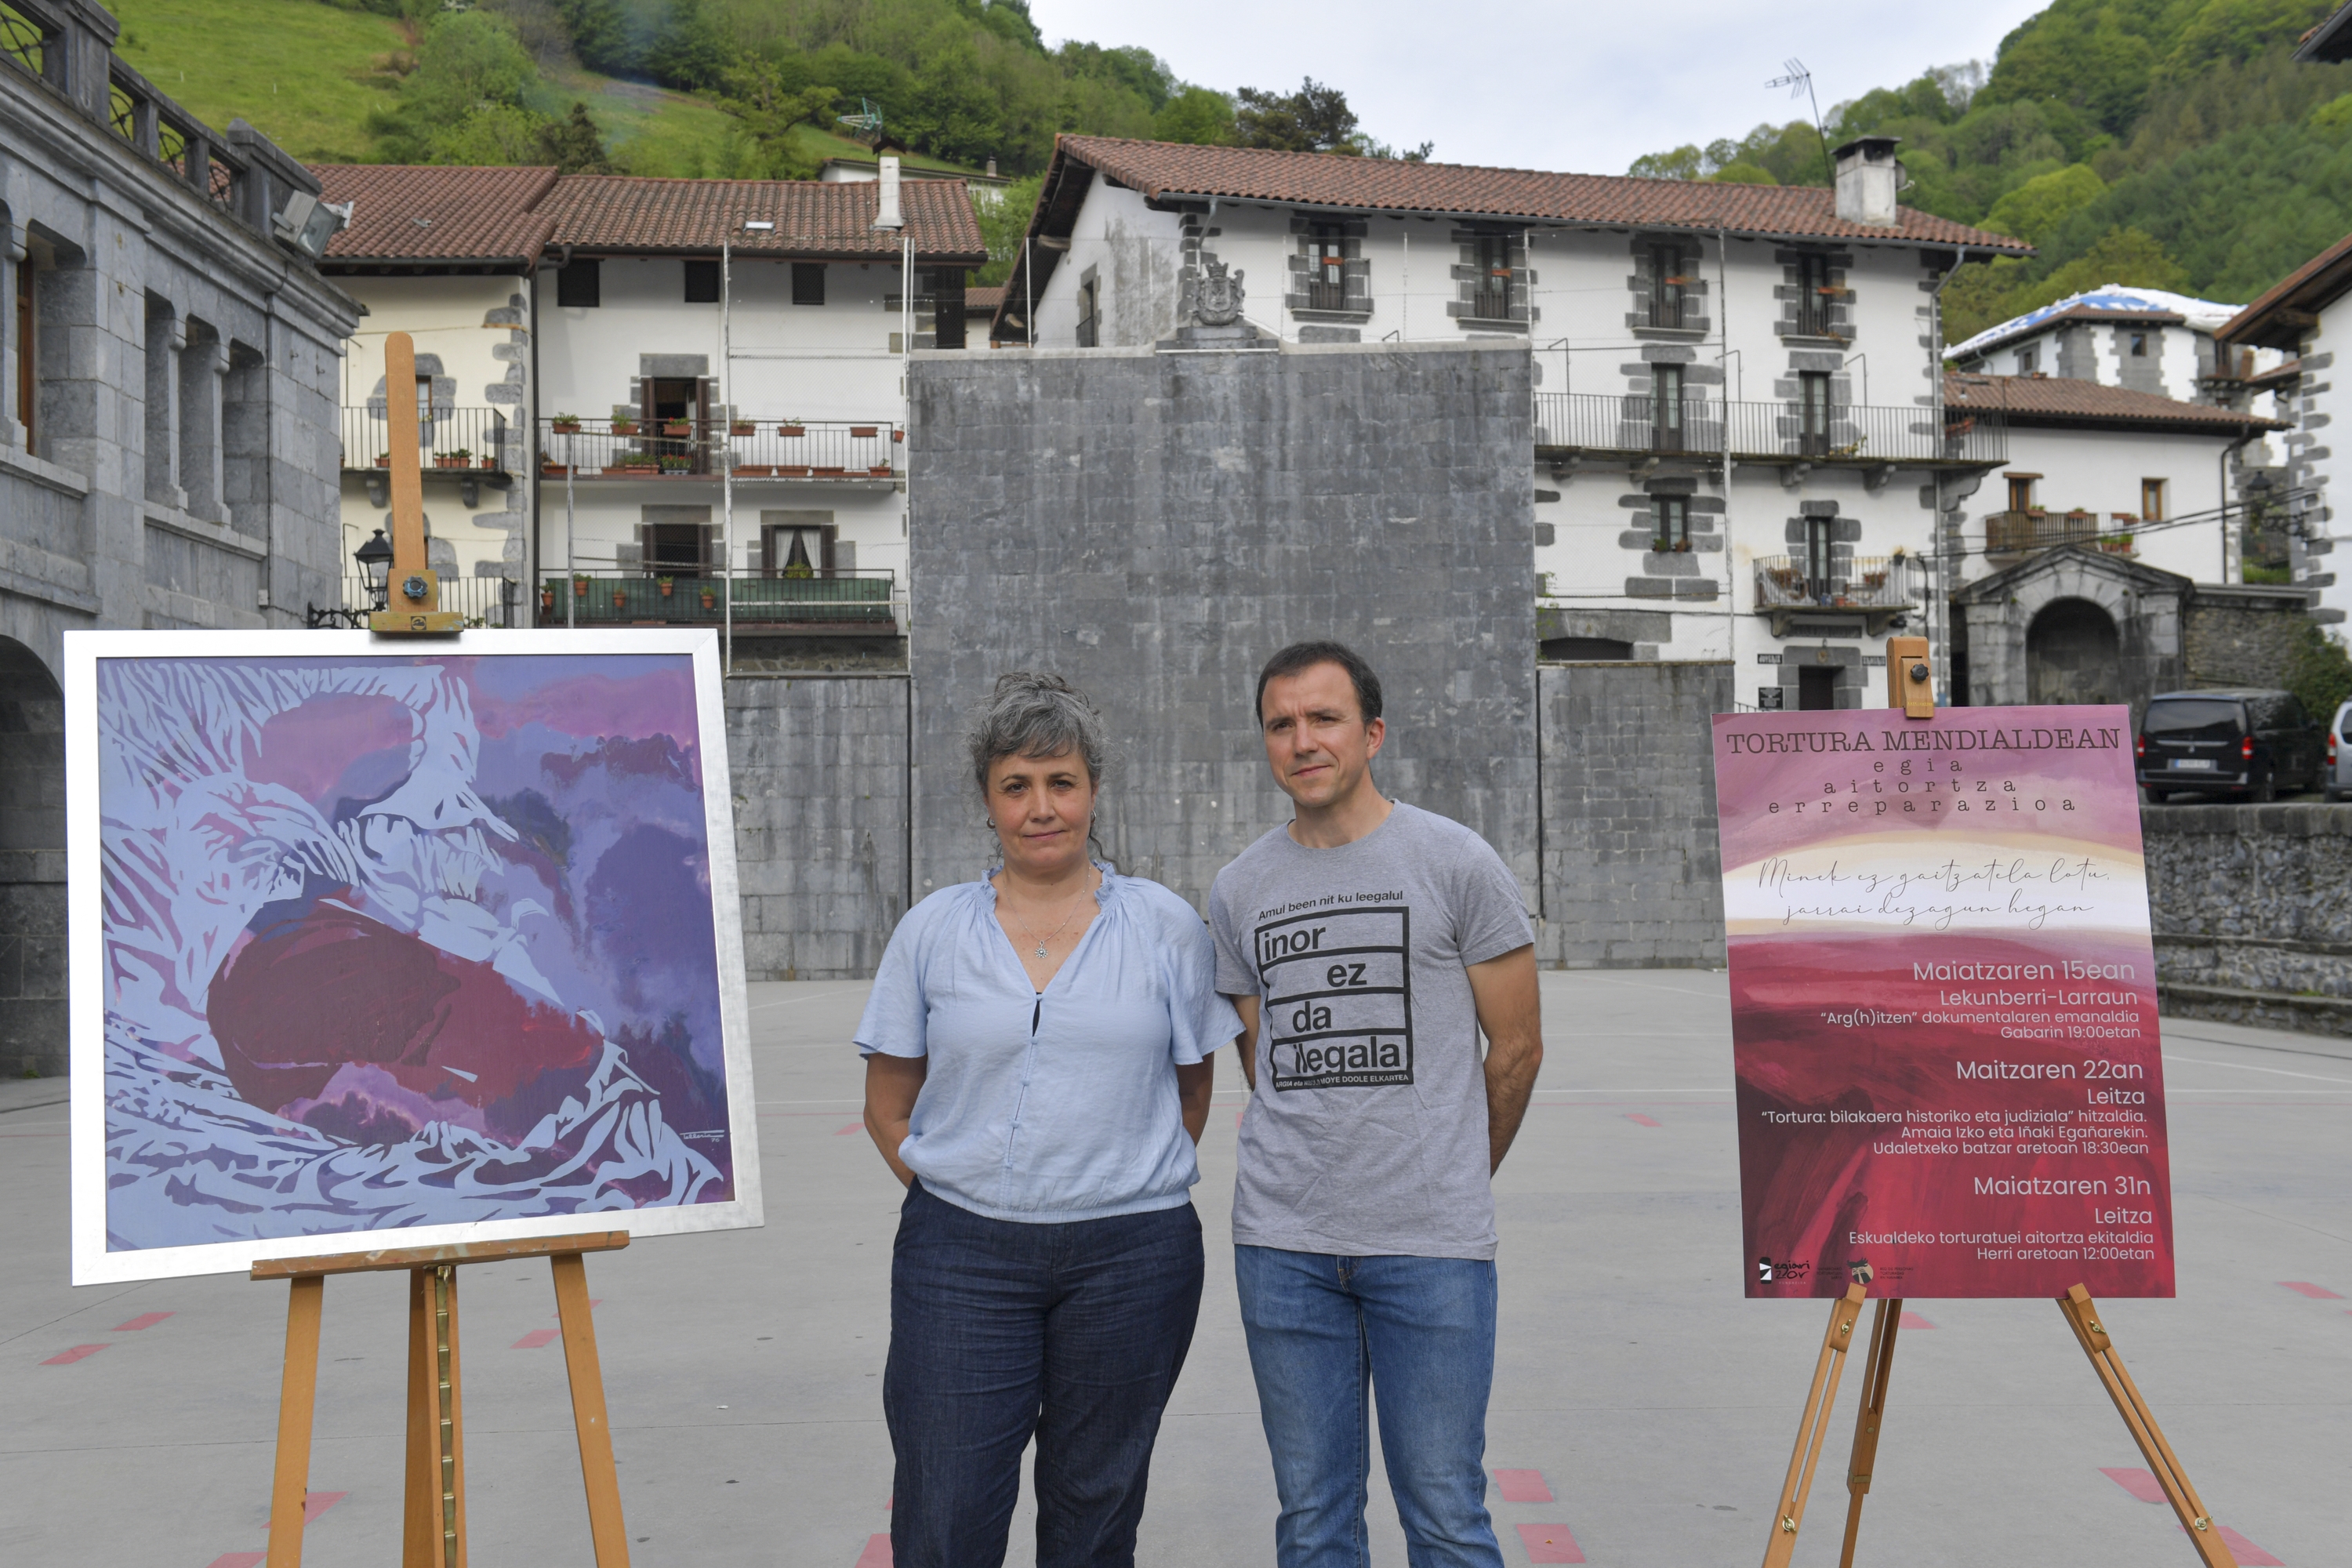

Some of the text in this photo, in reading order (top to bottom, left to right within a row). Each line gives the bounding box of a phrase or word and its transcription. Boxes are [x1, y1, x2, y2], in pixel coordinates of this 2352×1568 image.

[1726, 728, 2120, 753] TORTURA MENDIALDEAN
[1759, 858, 1850, 898] Minek
[1858, 873, 1893, 893] ez
[1890, 858, 2042, 898] gaitzatela
[1258, 890, 1403, 921] Amul been nit ku leegalul
[1783, 888, 2094, 931] jarrai dezagun hegan
[1265, 927, 1326, 961] inor
[1327, 963, 1367, 988] ez
[1914, 960, 2134, 980] Maiatzaren 15ean
[1941, 989, 2137, 1005] Lekunberri-Larraun
[1292, 1000, 1332, 1033] da
[1922, 1010, 2050, 1023] dokumentalaren
[2055, 1010, 2140, 1022] emanaldia
[2001, 1026, 2140, 1038] Gabarin 19:00etan
[1293, 1036, 1401, 1074] ilegala
[1957, 1060, 2143, 1079] Maitzaren 22an
[1320, 1076, 1340, 1085] MOYE
[1342, 1075, 1368, 1083] DOOLE
[1370, 1073, 1409, 1083] ELKARTEA
[2088, 1087, 2144, 1104] Leitza
[1831, 1110, 1901, 1123] bilakaera
[1907, 1110, 1970, 1122] historiko
[1976, 1111, 2000, 1122] eta
[2078, 1109, 2147, 1122] hitzaldia.
[1902, 1126, 2148, 1142] Amaia Izko eta Iñaki Egañarekin.
[1874, 1142, 2148, 1154] Udaletxeko batzar aretoan 18:30ean
[1975, 1175, 2150, 1195] Maiatzaren 31n
[2096, 1207, 2151, 1224] Leitza
[1849, 1231, 2153, 1243] Eskualdeko torturatuei aitortza ekitaldia
[1978, 1247, 2154, 1259] Herri aretoan 12:00etan
[1774, 1260, 1810, 1277] egiari
